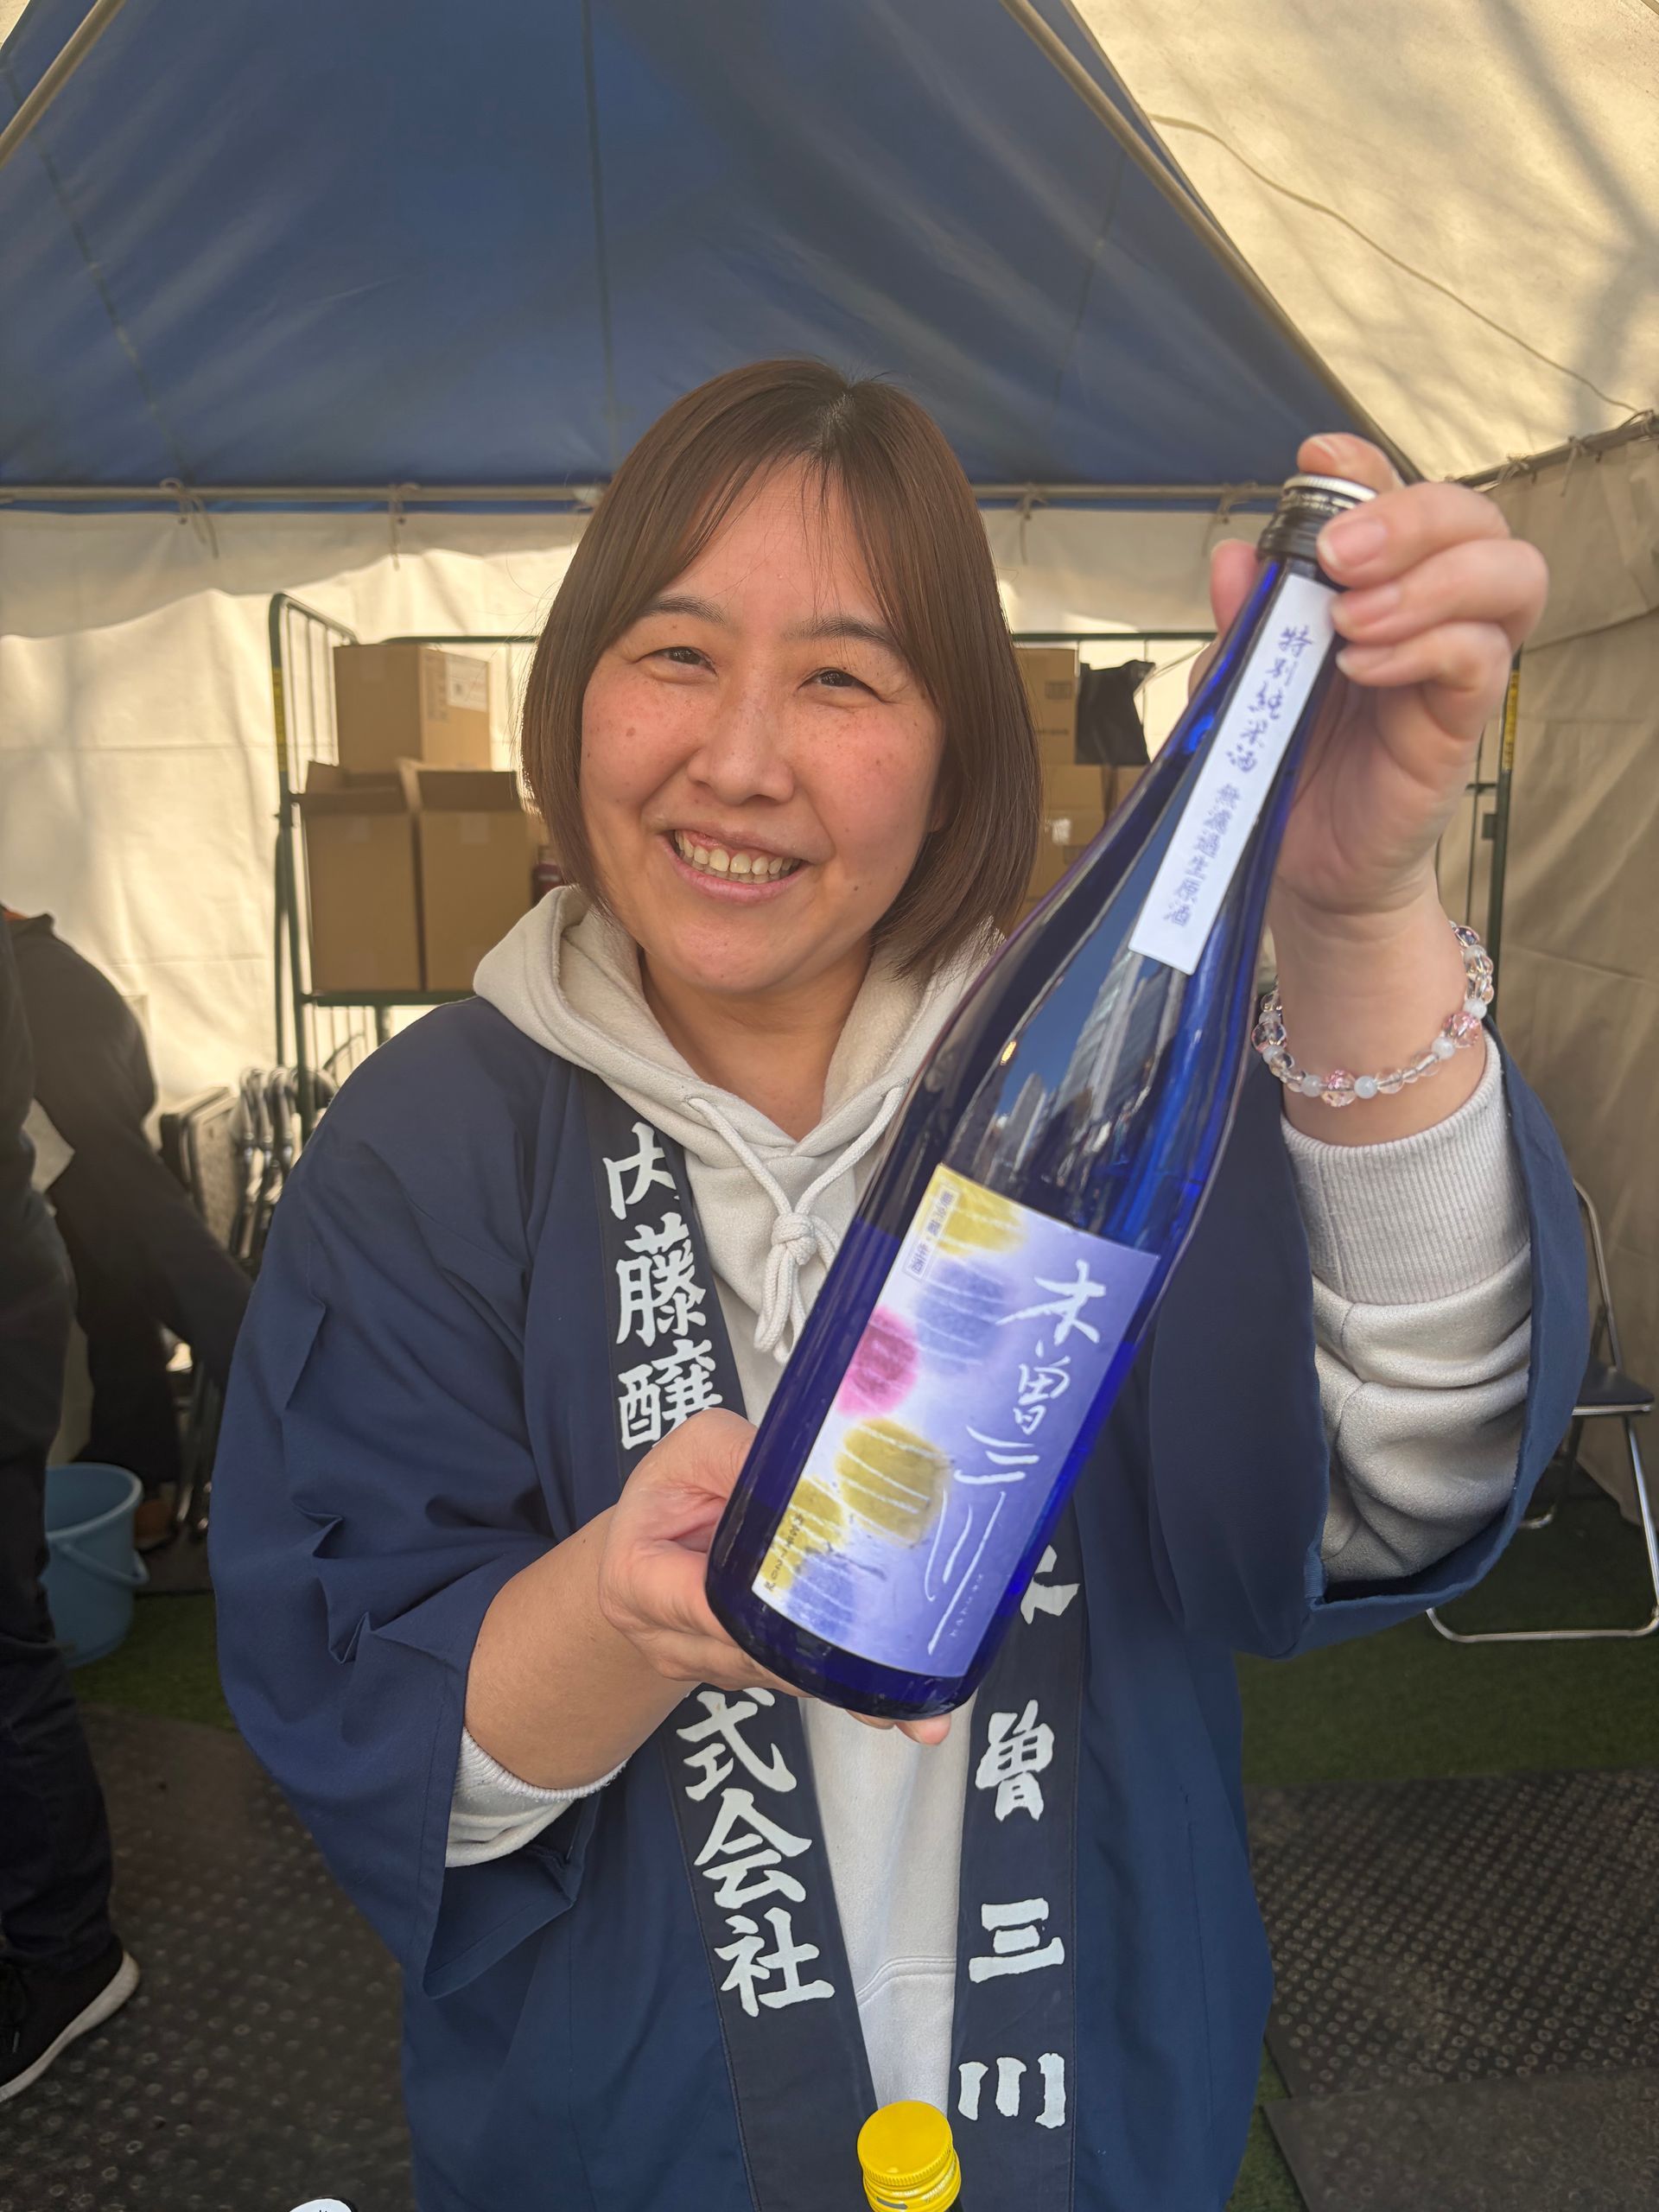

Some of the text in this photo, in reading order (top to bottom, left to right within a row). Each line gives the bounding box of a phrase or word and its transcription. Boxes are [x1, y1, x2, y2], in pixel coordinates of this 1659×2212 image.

[1228, 626, 1313, 773] 特別純米酒
[924, 1259, 1107, 1656] 木曽三川
[677, 1688, 835, 2017] 式会社
